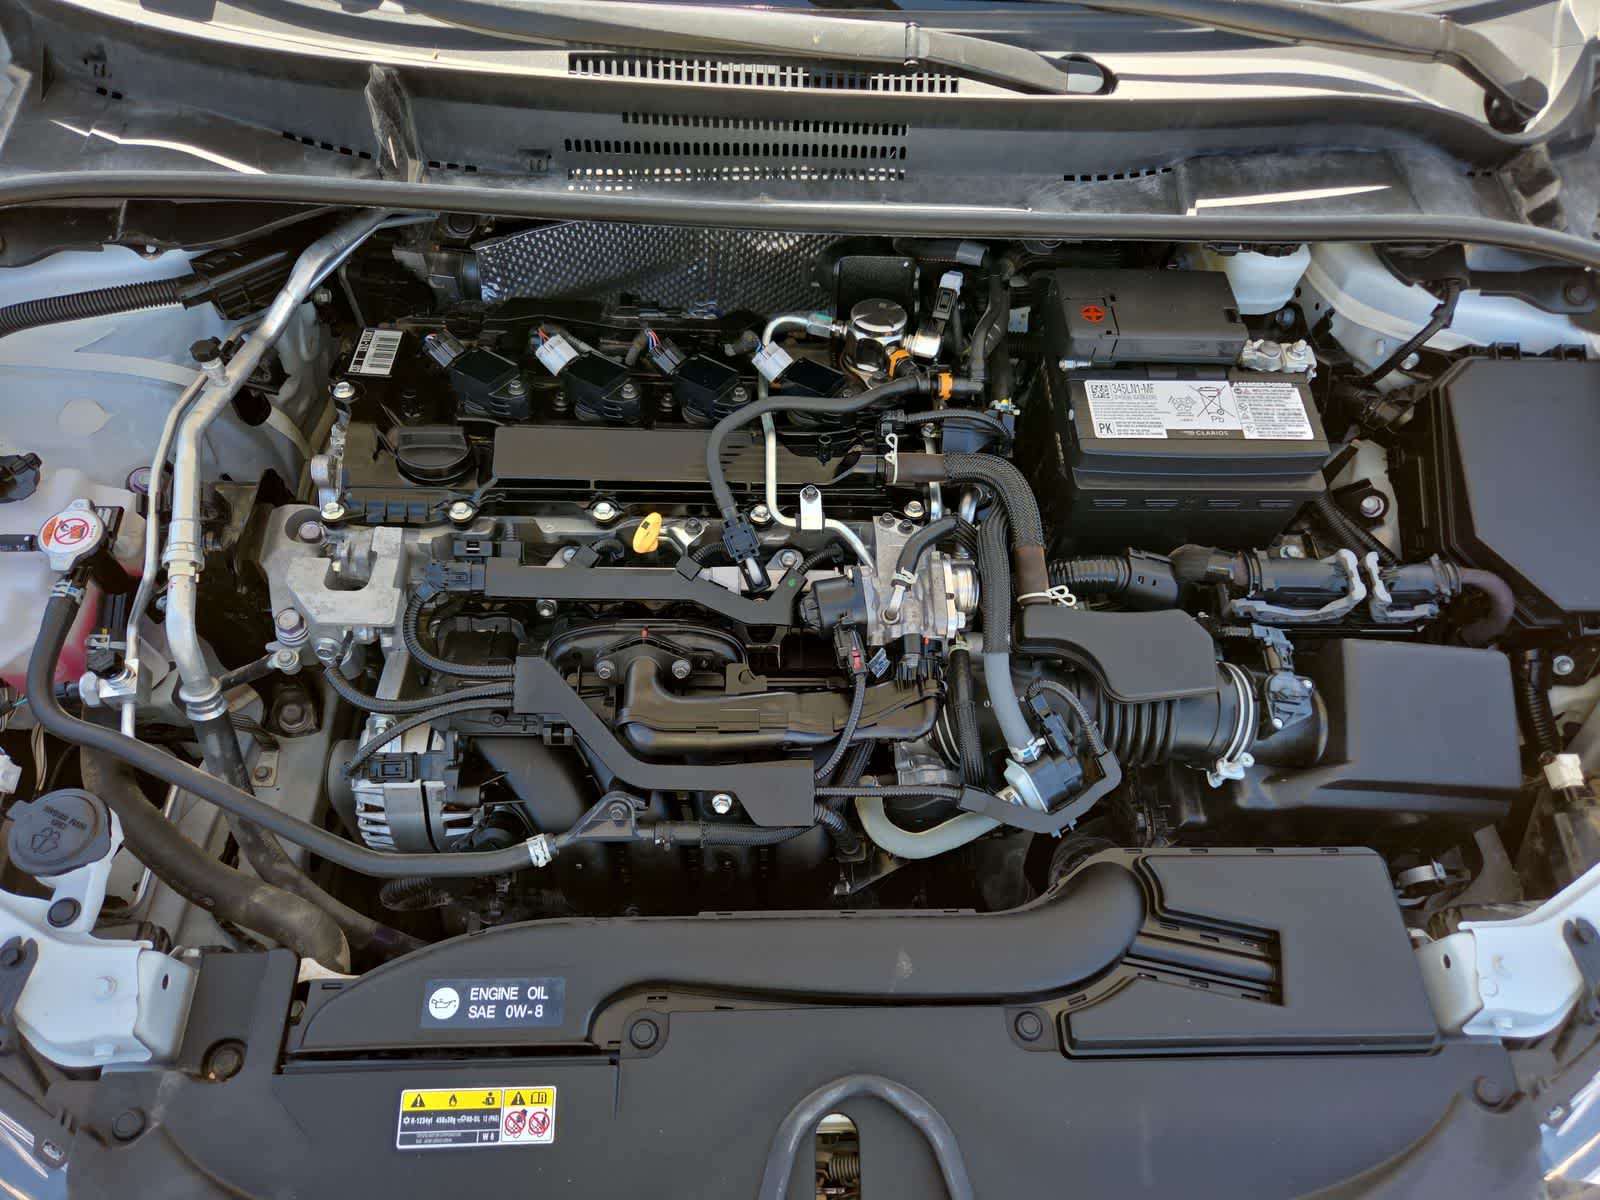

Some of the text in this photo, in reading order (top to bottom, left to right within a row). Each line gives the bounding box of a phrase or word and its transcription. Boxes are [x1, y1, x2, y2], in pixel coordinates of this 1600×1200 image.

[1210, 415, 1225, 423] Pb
[1098, 422, 1114, 434] PK
[470, 986, 549, 1001] ENGINE OIL
[468, 1004, 543, 1019] SAE 0W-8
